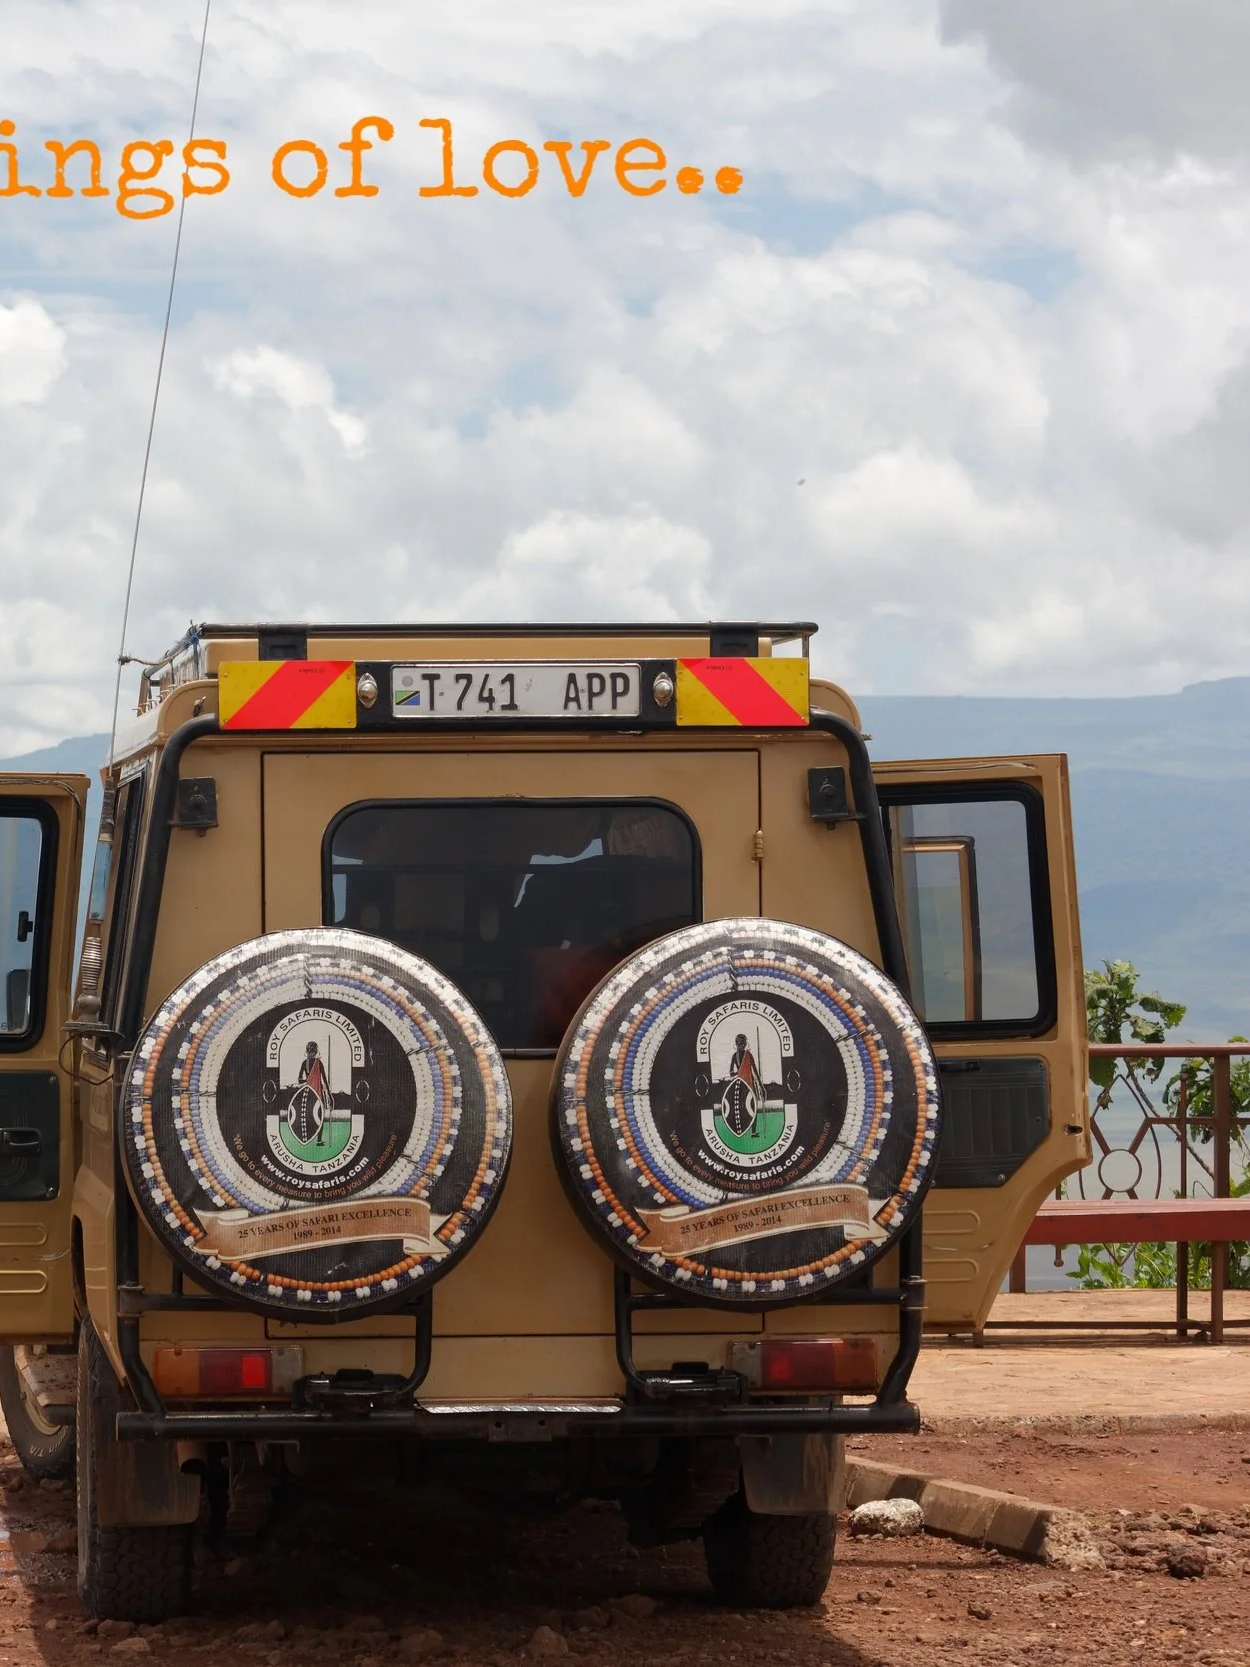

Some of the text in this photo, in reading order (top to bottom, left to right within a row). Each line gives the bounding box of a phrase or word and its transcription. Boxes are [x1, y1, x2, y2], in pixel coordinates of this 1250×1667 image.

[421, 672, 631, 711] T 741 APP
[270, 1009, 362, 1062] ROY SAFARIS LIMITED
[700, 1002, 791, 1055] ROY SAFARIS LIMITED
[270, 1134, 360, 1173] ARUSHA TANZANIA
[698, 1146, 805, 1181] www.roysafaris.com
[706, 1124, 794, 1164] ARUSHA TANZANIA
[238, 1151, 250, 1162] go
[248, 1161, 256, 1171] to
[254, 1169, 276, 1188] every
[276, 1184, 312, 1198] measure
[314, 1191, 322, 1199] to
[325, 1186, 346, 1198] bring
[347, 1180, 362, 1191] you
[362, 1167, 377, 1180] wild
[261, 1154, 370, 1189] www.roysafaris.com
[676, 1147, 686, 1157] go
[685, 1156, 693, 1165] to
[693, 1164, 714, 1180] every
[714, 1178, 749, 1190] measure
[752, 1182, 760, 1190] to
[762, 1177, 783, 1188] bring
[784, 1169, 799, 1181] you
[799, 1154, 813, 1169] wild
[238, 1208, 412, 1239] 25 YEARS OF SAFARI EXCELLENCE
[293, 1229, 313, 1241] 1989
[321, 1225, 342, 1236] 2014
[680, 1194, 850, 1235] 25 YEARS OF SAFARI EXCELLENCE
[734, 1222, 754, 1233] 1989
[761, 1216, 782, 1227] 2014
